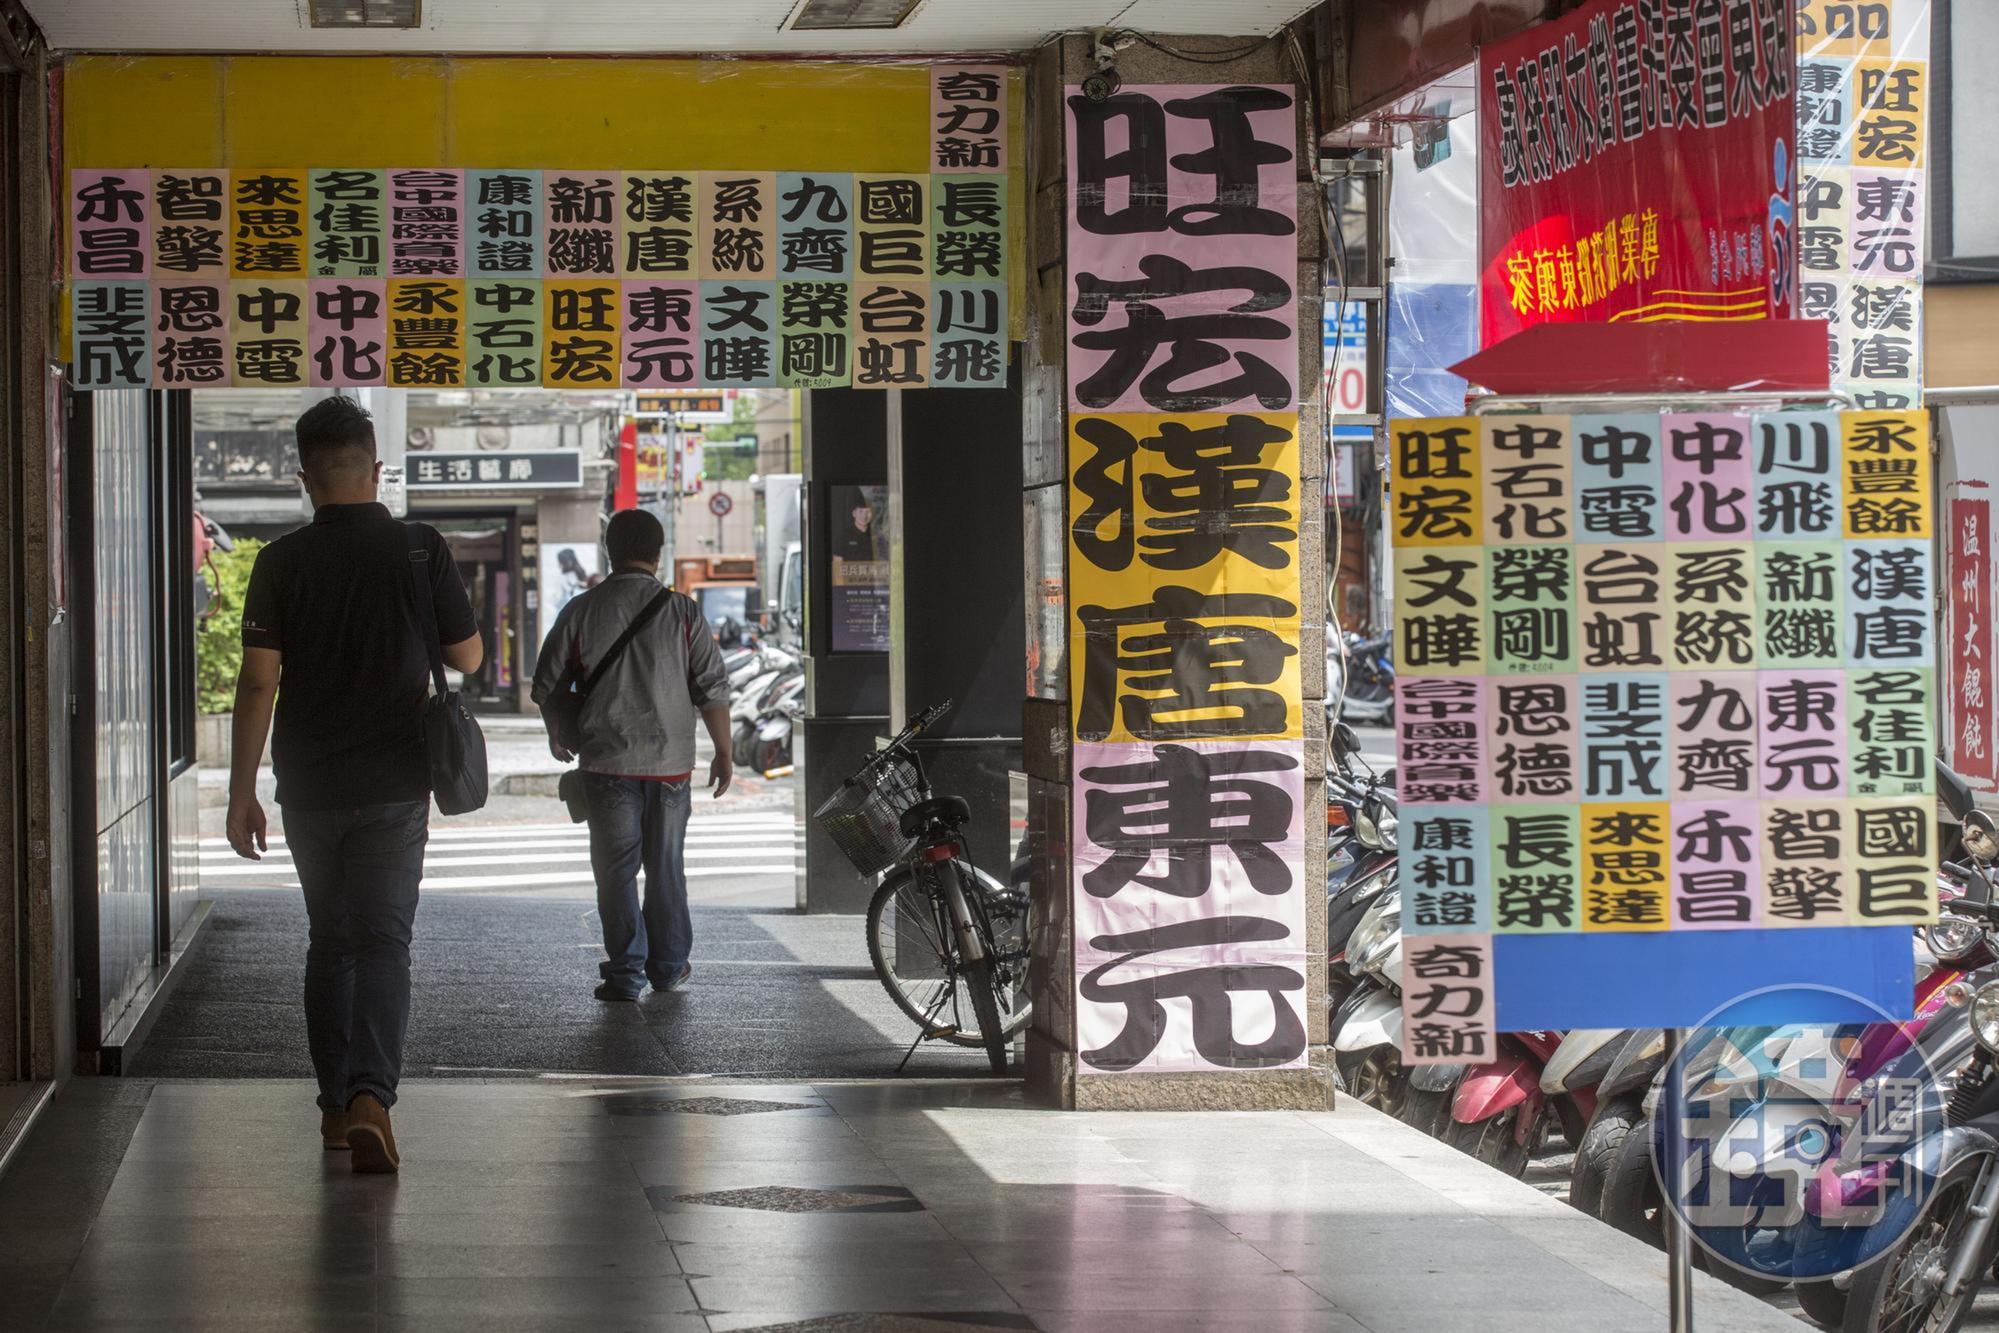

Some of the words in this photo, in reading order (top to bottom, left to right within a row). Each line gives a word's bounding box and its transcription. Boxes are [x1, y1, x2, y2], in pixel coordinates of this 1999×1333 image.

[936, 72, 1001, 167] 奇力新
[1858, 69, 1920, 162] 旺宏
[77, 177, 145, 274] 禾昌
[156, 175, 223, 272] 智擎
[235, 175, 302, 272] 來思達
[314, 172, 380, 264] 名佳利
[477, 175, 533, 271] 康和證
[549, 177, 615, 273] 新纖
[626, 177, 692, 272] 漢唐
[712, 179, 764, 272] 系統
[782, 178, 847, 273] 九齊
[859, 180, 924, 275] 國巨
[936, 182, 1001, 278] 長榮
[1066, 86, 1296, 412] 旺宏
[1853, 176, 1917, 273] 東元
[78, 287, 145, 384] 斐成
[157, 286, 224, 382] 恩德
[236, 288, 302, 383] 中電
[314, 285, 381, 381] 中化
[392, 283, 460, 384] 永豐餘
[472, 284, 535, 383] 中石化
[550, 288, 615, 382] 旺宏
[627, 287, 693, 382] 東元
[705, 286, 770, 381] 文曄
[782, 282, 848, 377] 榮剛
[859, 286, 925, 384] 台虹
[937, 289, 1001, 382] 川飛
[1850, 285, 1913, 379] 漢唐
[1398, 428, 1472, 538] 旺宏
[1492, 424, 1566, 538] 中石化
[1580, 426, 1656, 536] 中電
[1670, 422, 1745, 534] 中化
[1758, 422, 1833, 534] 川飛
[1847, 419, 1921, 533] 永豐餘
[1073, 415, 1298, 740] 漢唐
[1493, 549, 1569, 656] 榮剛
[1583, 550, 1661, 666] 台虹
[1675, 549, 1750, 664] 系統
[1764, 551, 1837, 658] 新纖
[1852, 548, 1926, 659] 漢唐
[1495, 684, 1572, 795] 恩德
[1585, 683, 1662, 794] 斐成
[1677, 680, 1753, 791] 九齊
[1765, 679, 1839, 791] 東元
[1853, 672, 1926, 778] 名佳利
[1078, 744, 1306, 1072] 東元
[1413, 817, 1476, 926] 康和證
[1498, 815, 1573, 927] 長榮
[1589, 812, 1664, 924] 來思達
[1677, 810, 1752, 922] 禾昌
[1768, 808, 1842, 920] 智擎
[1856, 806, 1929, 917] 國巨
[1410, 945, 1486, 1056] 奇力新
